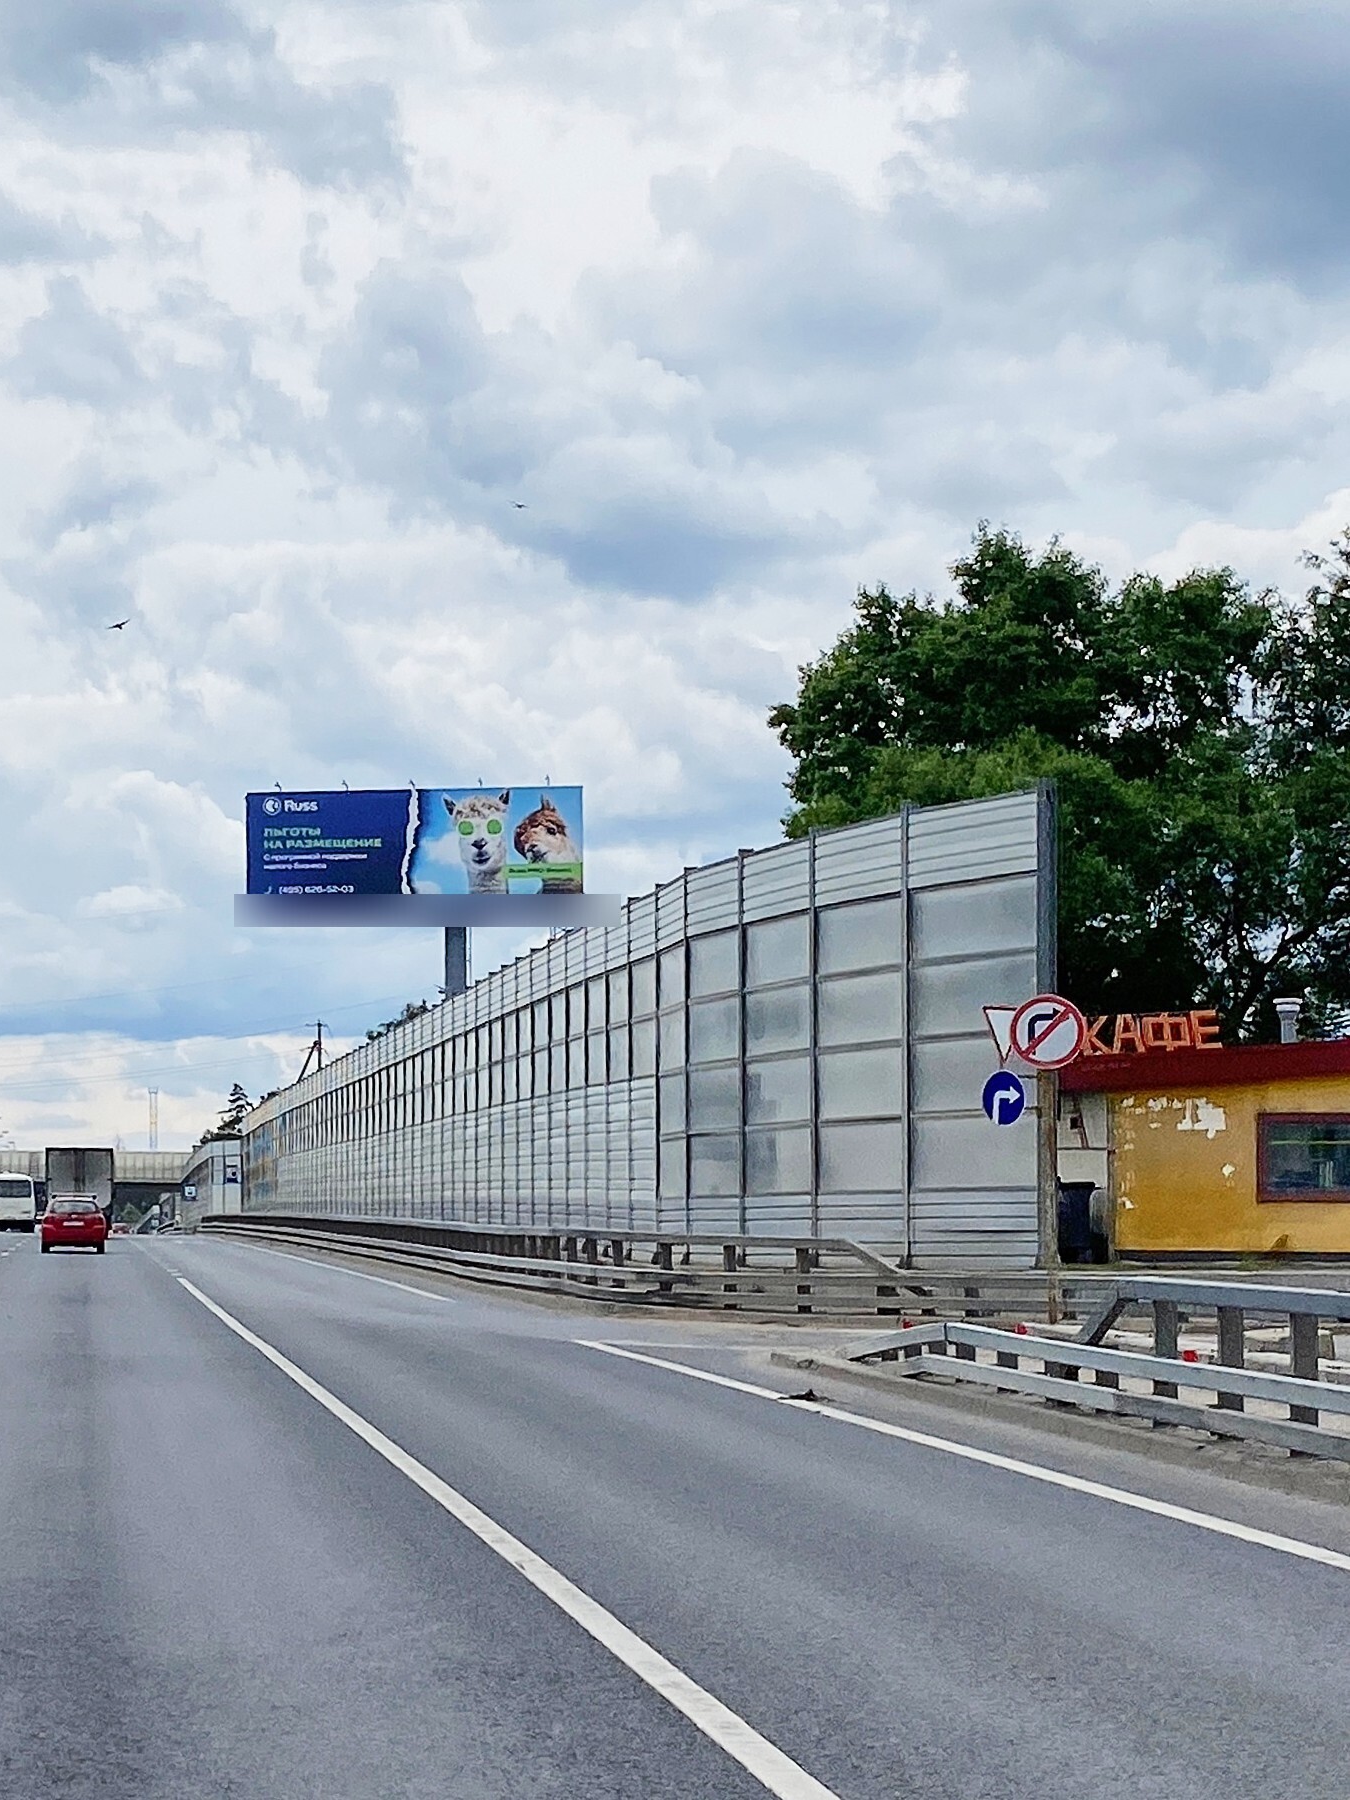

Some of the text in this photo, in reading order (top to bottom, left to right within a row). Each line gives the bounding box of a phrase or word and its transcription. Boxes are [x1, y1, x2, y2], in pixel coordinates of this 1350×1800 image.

[284, 799, 319, 812] Russ
[263, 827, 321, 837] ЛЬГОТЫ
[263, 838, 382, 849] НА РАЗМЕЩЕНИЕ
[1083, 1010, 1223, 1056] КАФЕ
